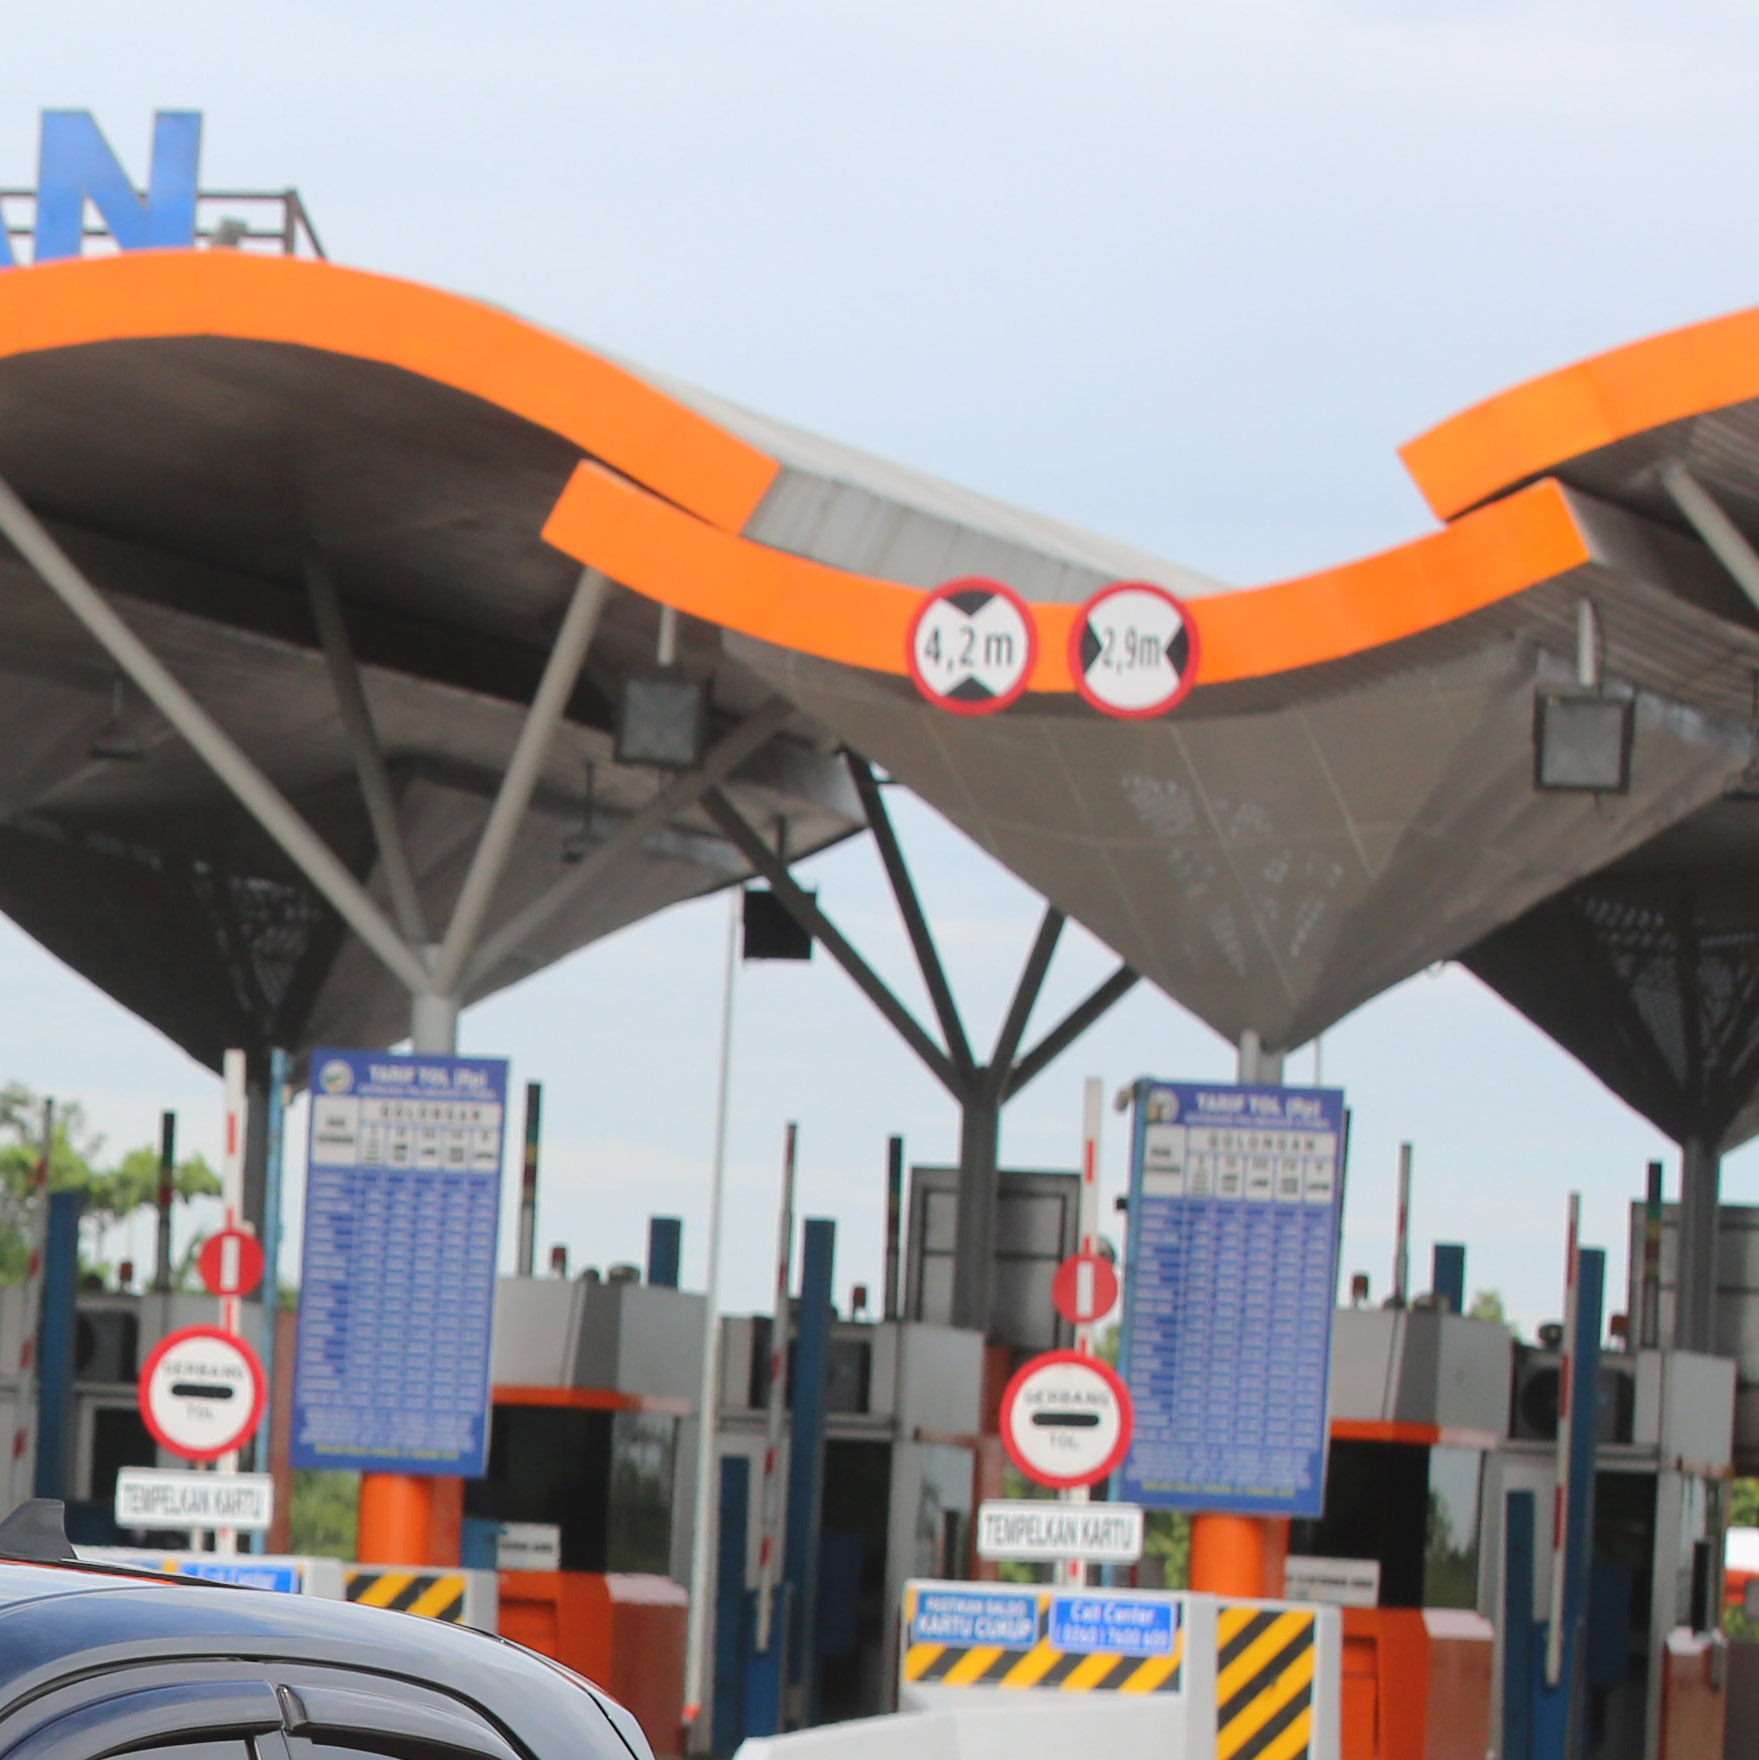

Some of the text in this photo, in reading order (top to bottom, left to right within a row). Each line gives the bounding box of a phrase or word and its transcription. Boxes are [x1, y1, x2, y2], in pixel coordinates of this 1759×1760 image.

[1101, 625, 1162, 674] 2,9m
[985, 1512, 1132, 1551] TEMPELKAN KARTU
